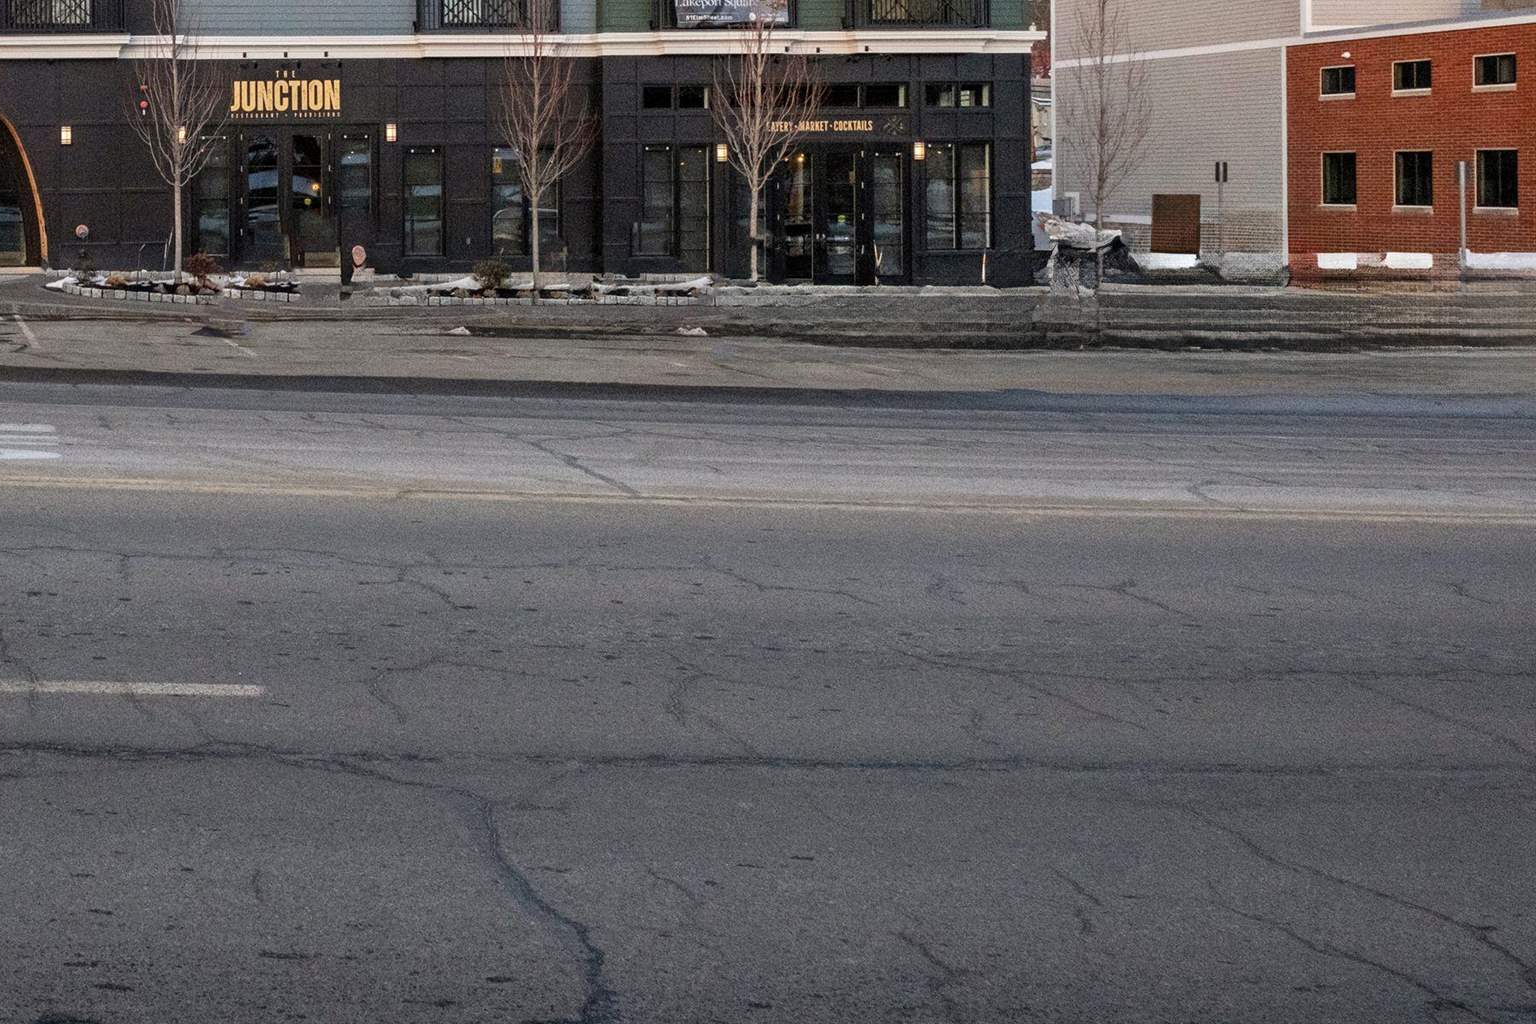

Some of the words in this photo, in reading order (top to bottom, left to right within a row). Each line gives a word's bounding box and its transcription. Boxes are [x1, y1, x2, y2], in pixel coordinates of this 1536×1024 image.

[275, 70, 296, 78] THE
[230, 79, 341, 112] JUNCTION
[798, 120, 828, 132] MARKET
[833, 120, 873, 131] COCKTAILS
